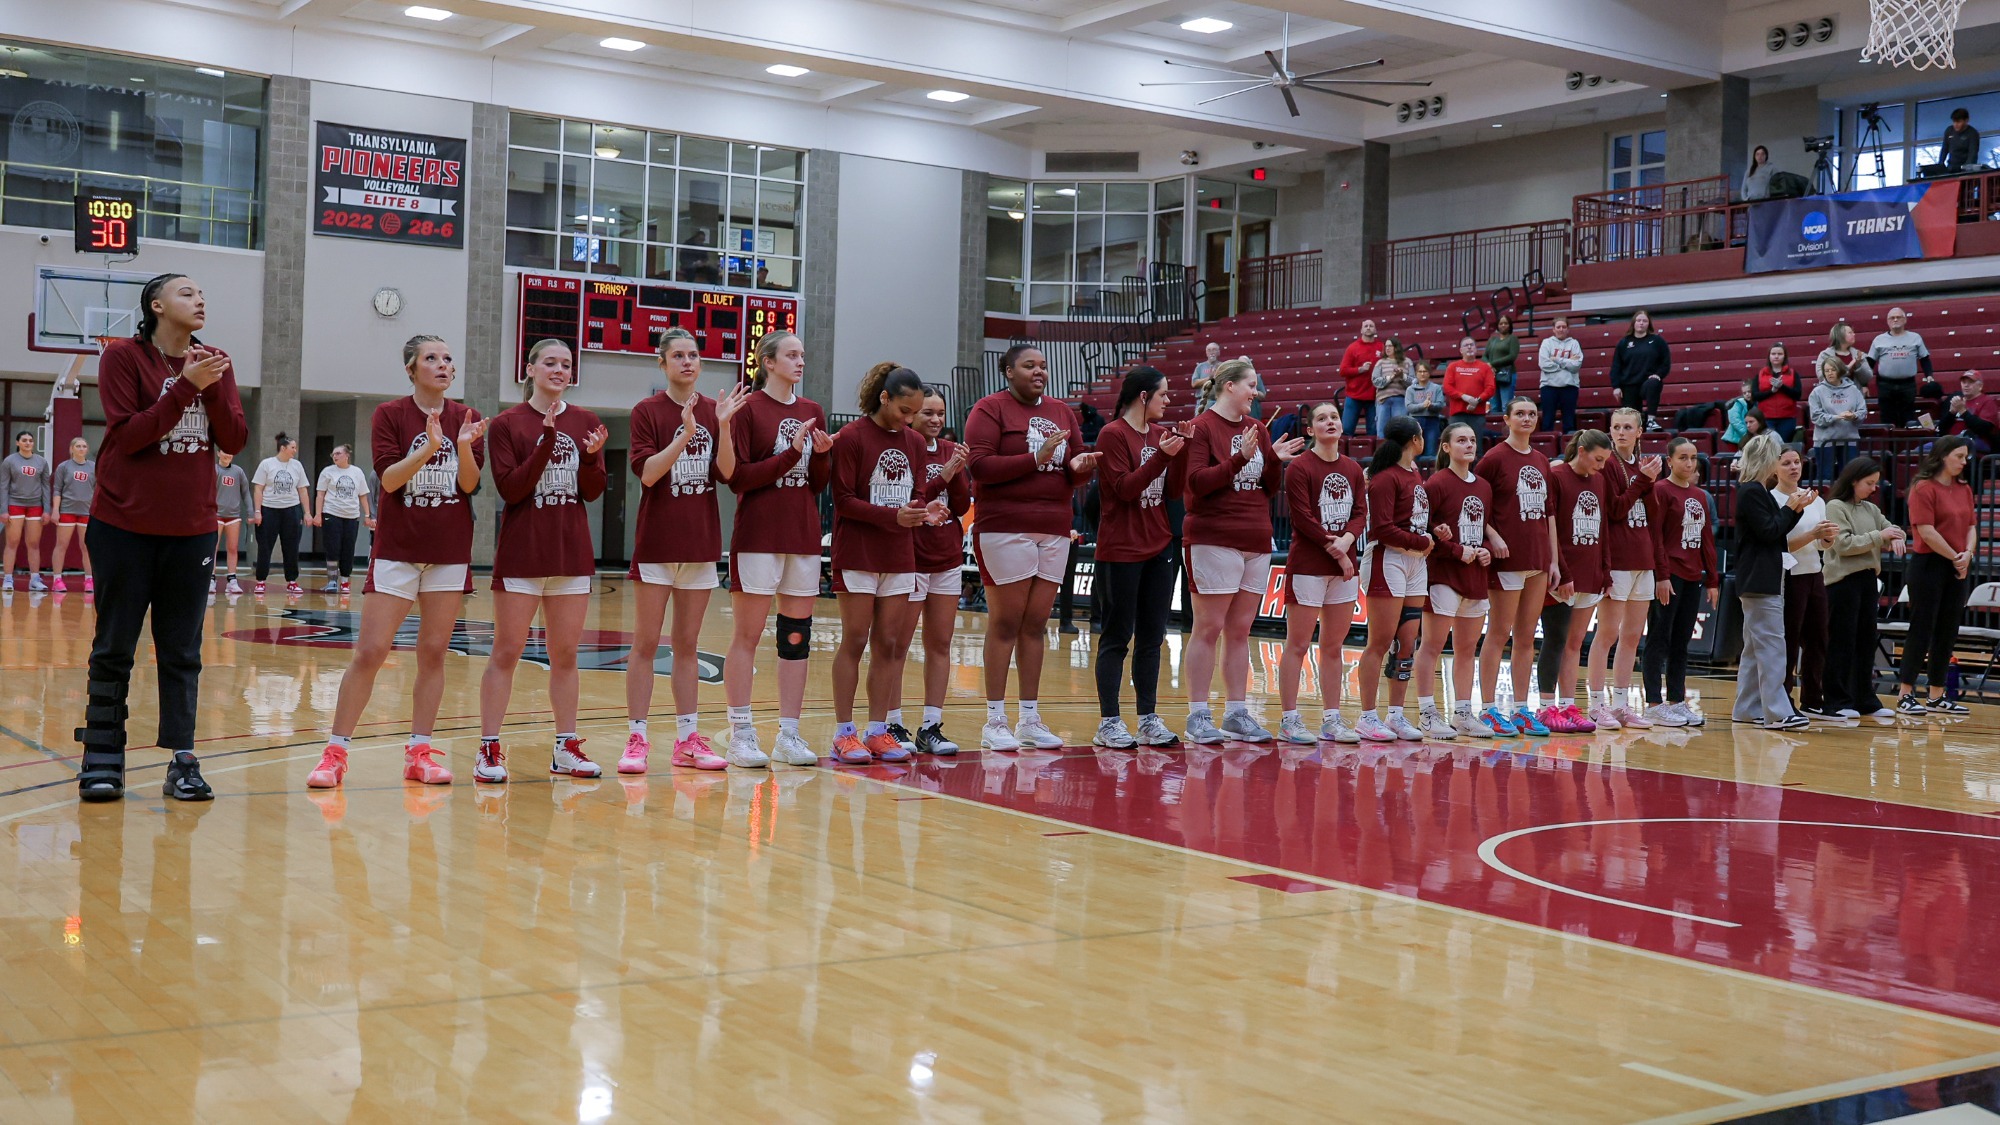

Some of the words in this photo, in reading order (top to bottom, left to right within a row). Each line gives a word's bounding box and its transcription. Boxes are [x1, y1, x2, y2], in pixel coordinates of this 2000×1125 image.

[348, 132, 437, 156] TRANSYLVANIA
[321, 145, 461, 188] PIONEERS
[363, 179, 421, 195] VOLLEYBALL
[363, 194, 406, 208] ELITE
[410, 199, 420, 209] 8
[88, 201, 133, 219] 10:00
[321, 209, 375, 230] 2022
[1846, 215, 1906, 236] TRANSY
[92, 219, 126, 248] 30
[407, 219, 454, 238] 28-6
[1803, 224, 1828, 235] NCAA
[1797, 243, 1824, 252] Division
[528, 278, 542, 287] PLYR
[547, 279, 558, 288] FLS
[564, 281, 576, 290] PTS
[594, 282, 629, 296] TRANSY
[702, 292, 735, 306] OLIVET
[750, 299, 763, 307] PLYR
[767, 300, 777, 309] FLS
[782, 302, 792, 310] PTS
[588, 320, 604, 329] FOULS
[650, 314, 668, 322] PERIOD
[755, 309, 764, 323] 0
[767, 311, 777, 324] 0
[786, 313, 795, 326] 0
[722, 332, 737, 340] FOULS
[751, 324, 764, 337] 10
[587, 342, 604, 350] SCORE
[869, 484, 913, 505] HOLIDAY
